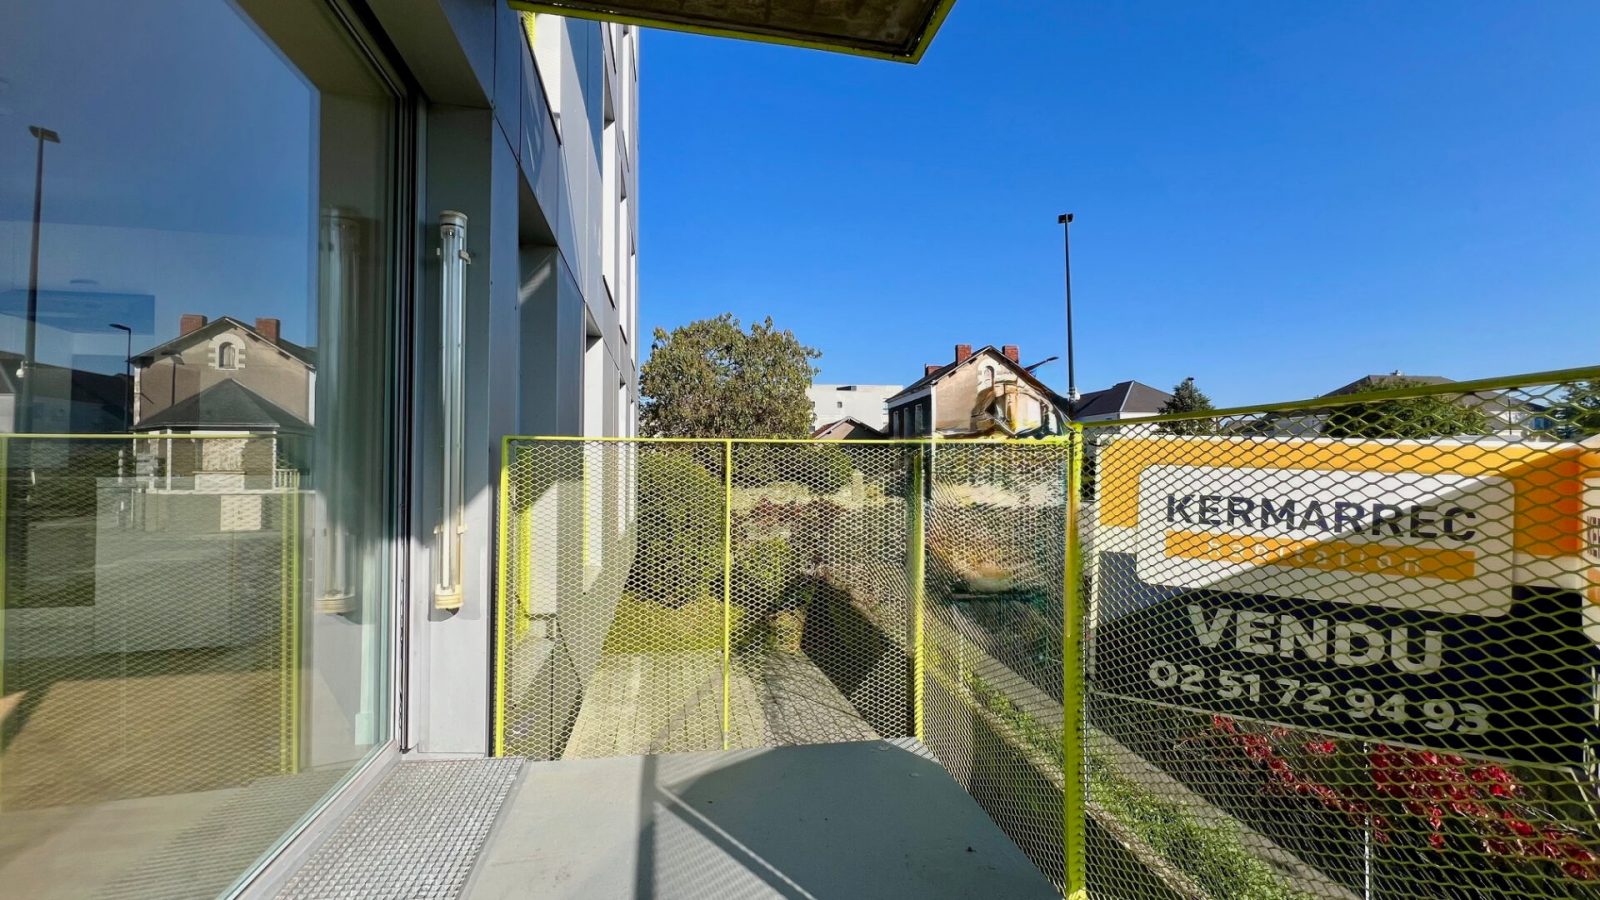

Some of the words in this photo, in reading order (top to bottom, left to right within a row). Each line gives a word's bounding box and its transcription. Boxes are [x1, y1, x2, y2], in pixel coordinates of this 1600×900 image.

[1165, 493, 1477, 542] KERMARREC
[1187, 603, 1443, 675] VENDU
[1149, 659, 1205, 694] 02
[1216, 668, 1260, 702] 51
[1275, 678, 1332, 713] 72
[1345, 687, 1407, 723] 94
[1422, 698, 1490, 735] 93
